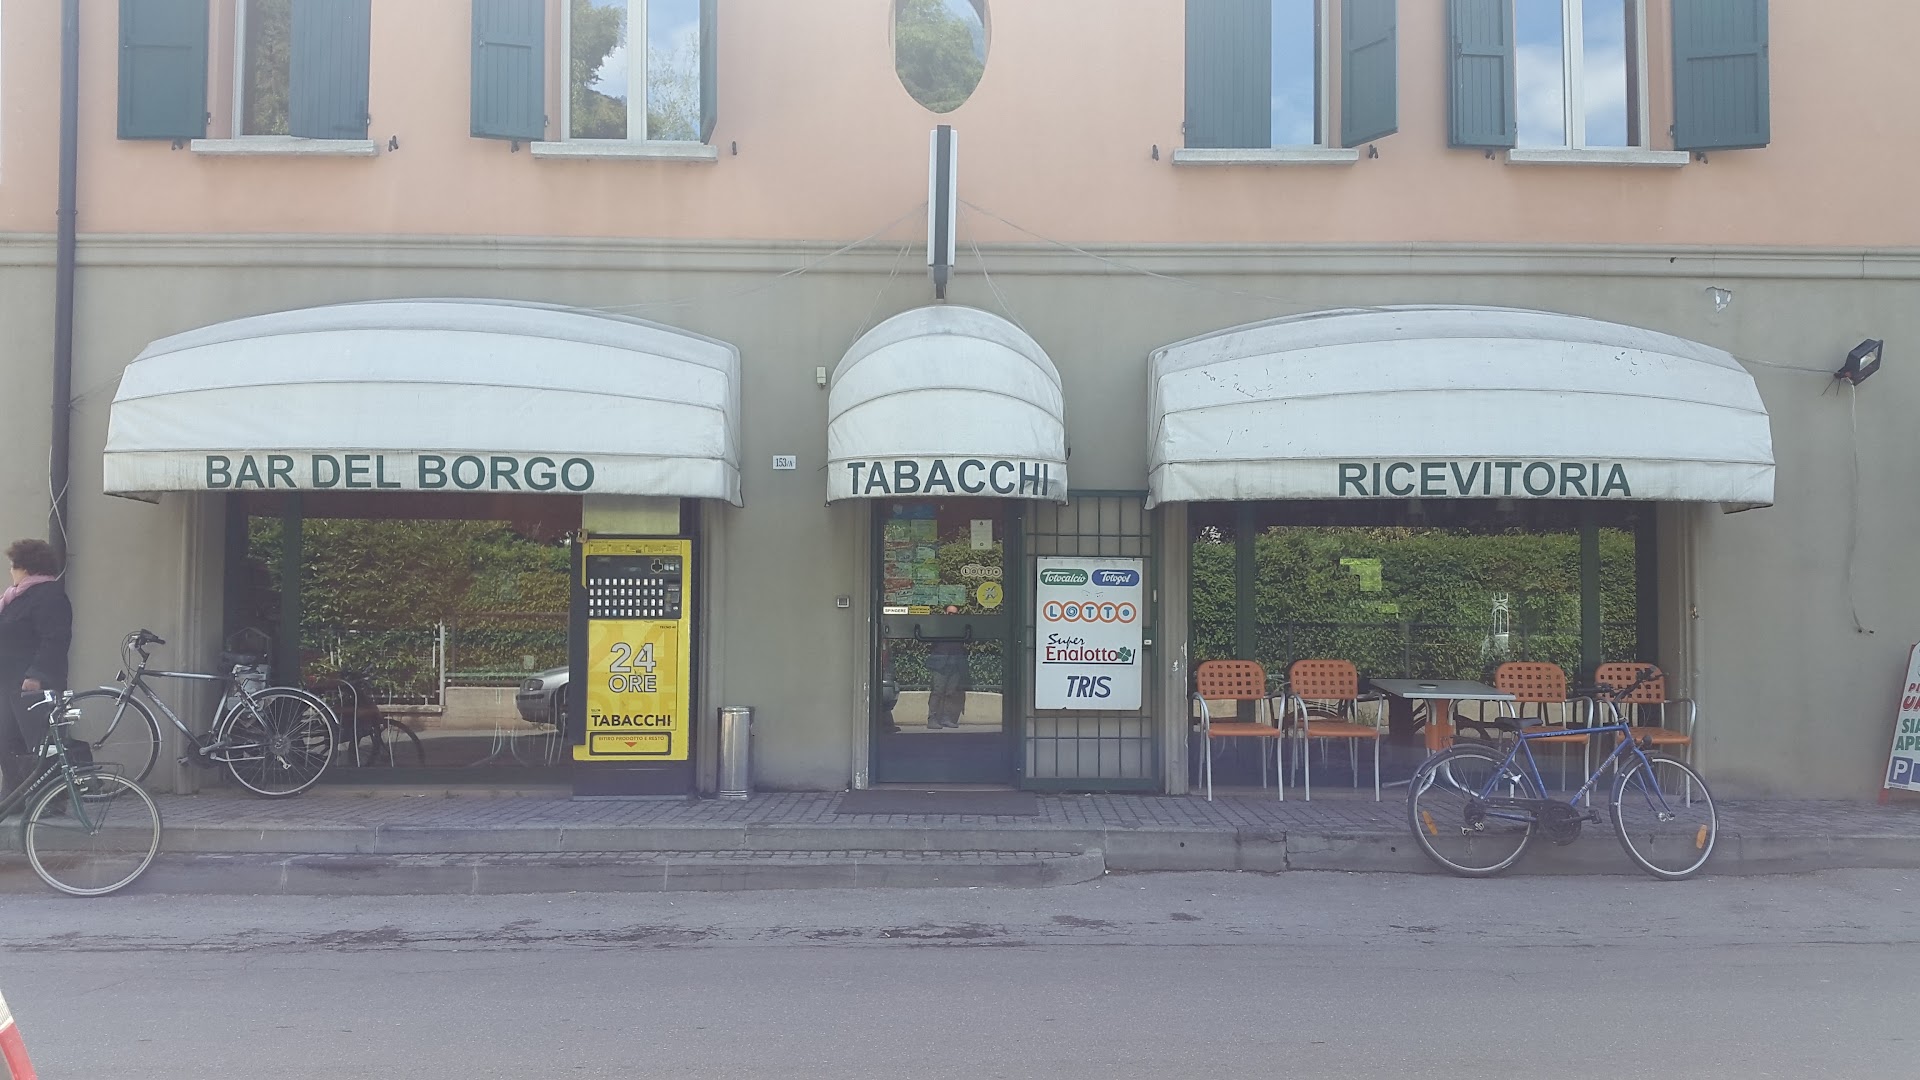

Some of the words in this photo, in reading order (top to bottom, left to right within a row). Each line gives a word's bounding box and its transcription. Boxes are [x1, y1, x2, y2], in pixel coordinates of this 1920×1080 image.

[206, 455, 297, 489] BAR
[312, 455, 401, 488] DEL
[418, 455, 595, 491] BORGO
[847, 459, 1049, 496] TABACCHI
[1338, 462, 1632, 497] RICEVITORIA
[1042, 570, 1086, 583] Totocalcio
[1100, 570, 1131, 585] Totogol
[1048, 633, 1085, 649] Super
[610, 642, 657, 673] 24
[1046, 646, 1118, 662] Enalotto
[608, 674, 657, 693] ORE
[1067, 675, 1112, 698] TRIS
[591, 714, 671, 726] TABACCHI
